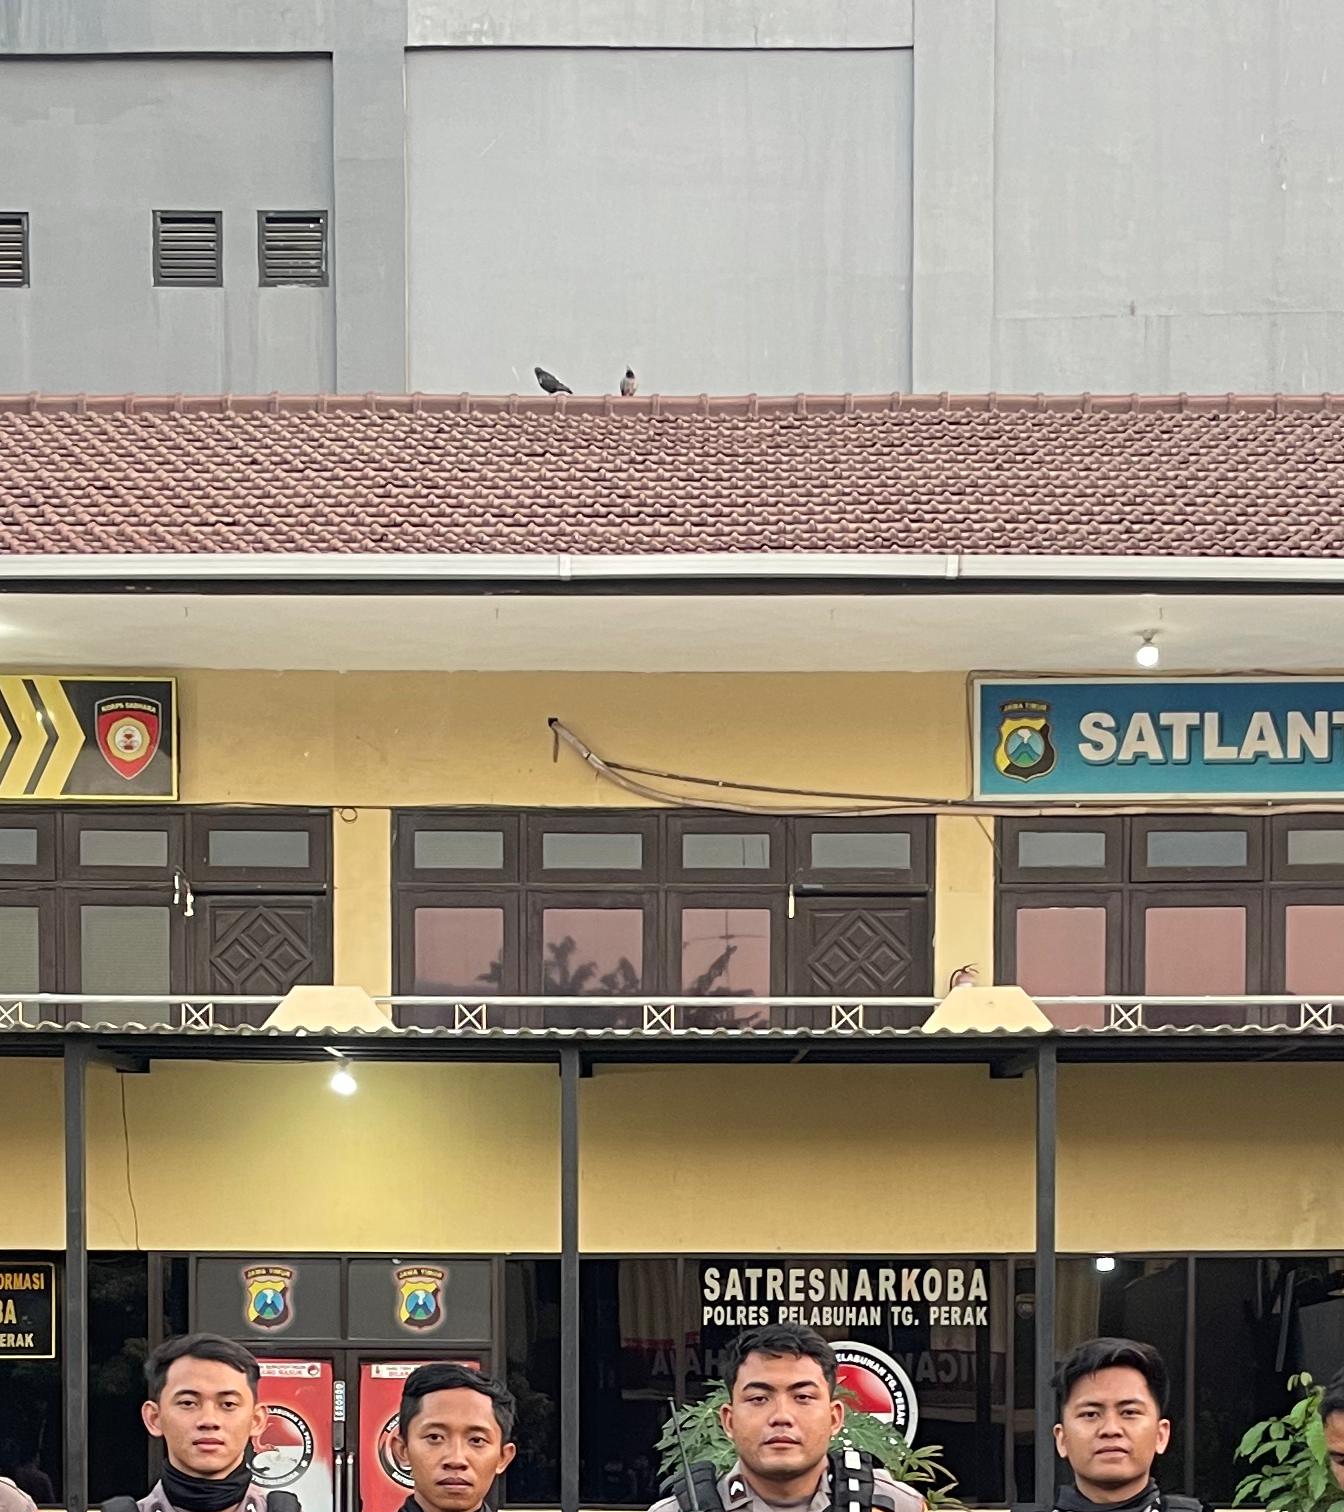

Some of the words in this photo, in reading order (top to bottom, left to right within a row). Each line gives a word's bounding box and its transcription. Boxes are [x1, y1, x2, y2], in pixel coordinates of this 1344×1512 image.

[704, 1267, 988, 1302] SATRESNARKOBA
[703, 1306, 770, 1327] POLRES
[778, 1306, 882, 1327] PELABUHAN
[891, 1306, 920, 1327] TG.
[929, 1306, 988, 1327] PERAK
[834, 1353, 887, 1377] ELABUHAN
